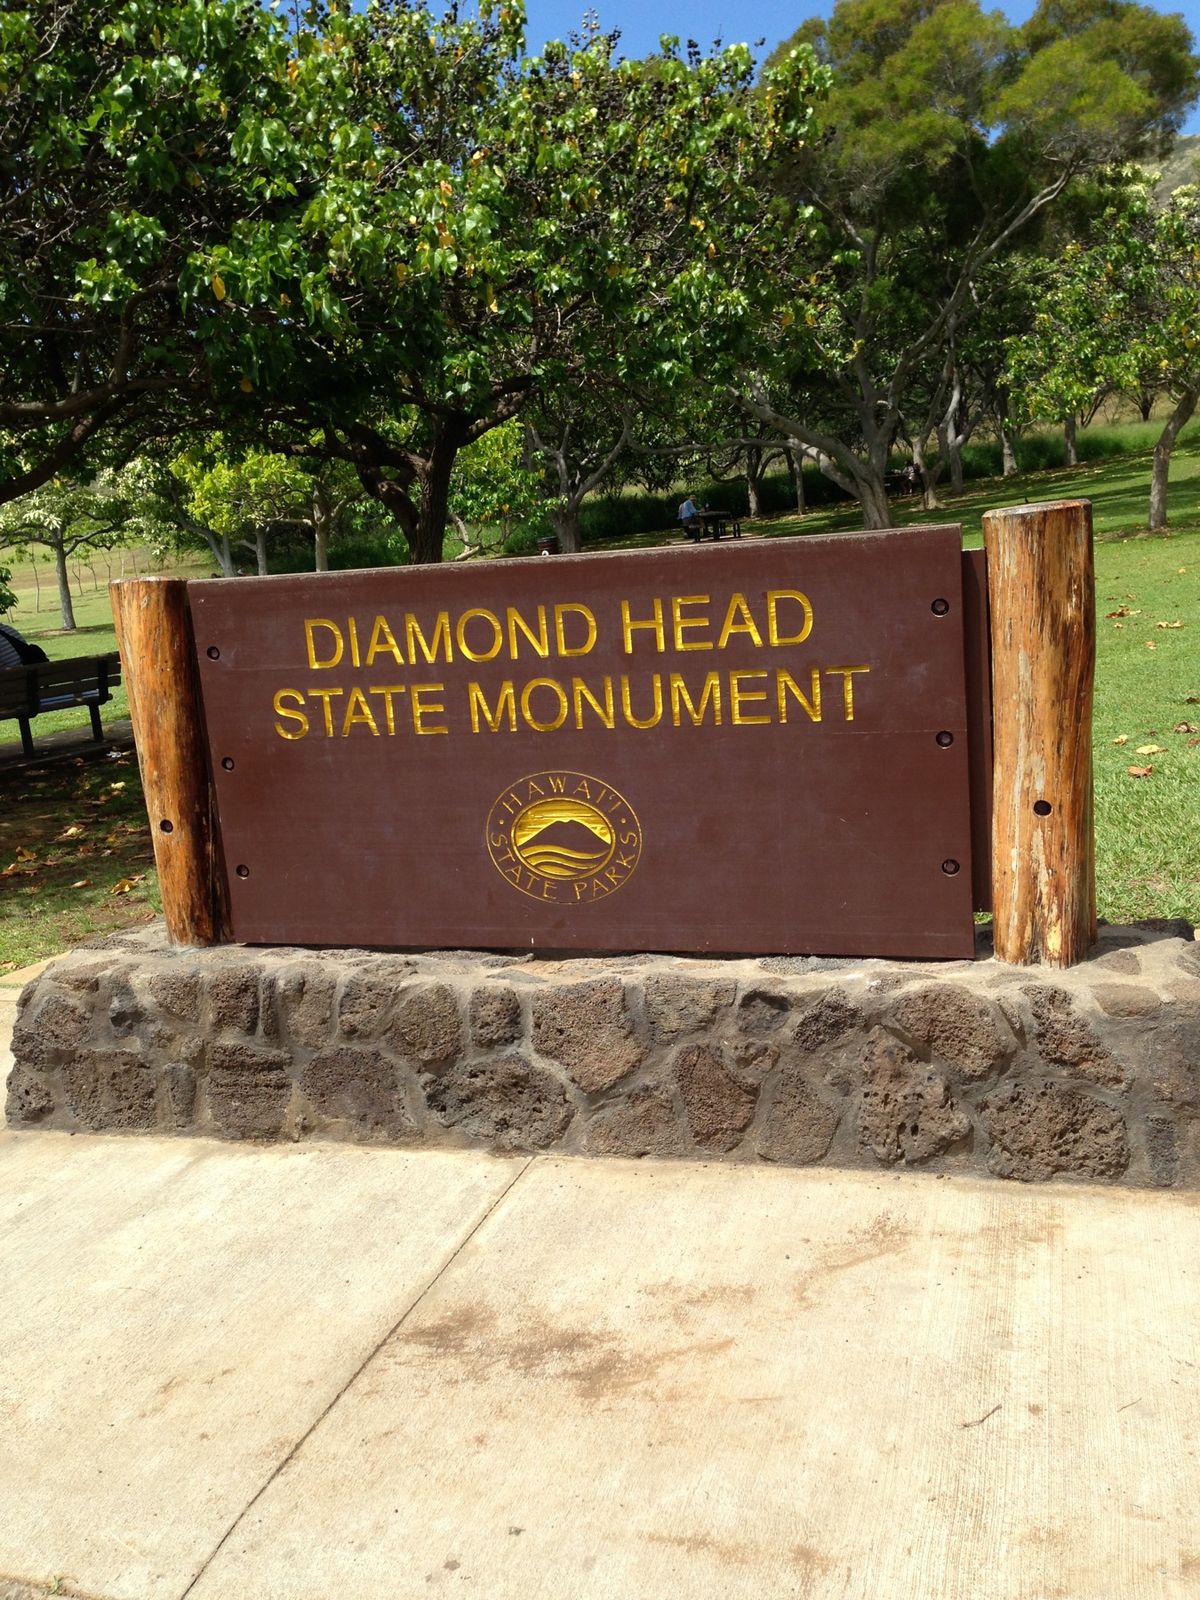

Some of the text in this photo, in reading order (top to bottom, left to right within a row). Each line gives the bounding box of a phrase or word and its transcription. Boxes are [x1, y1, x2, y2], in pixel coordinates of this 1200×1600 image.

[304, 589, 814, 669] DIAMOND HEAD
[273, 665, 871, 740] STATE MONUMENT
[490, 831, 638, 900] STATE PARKS
